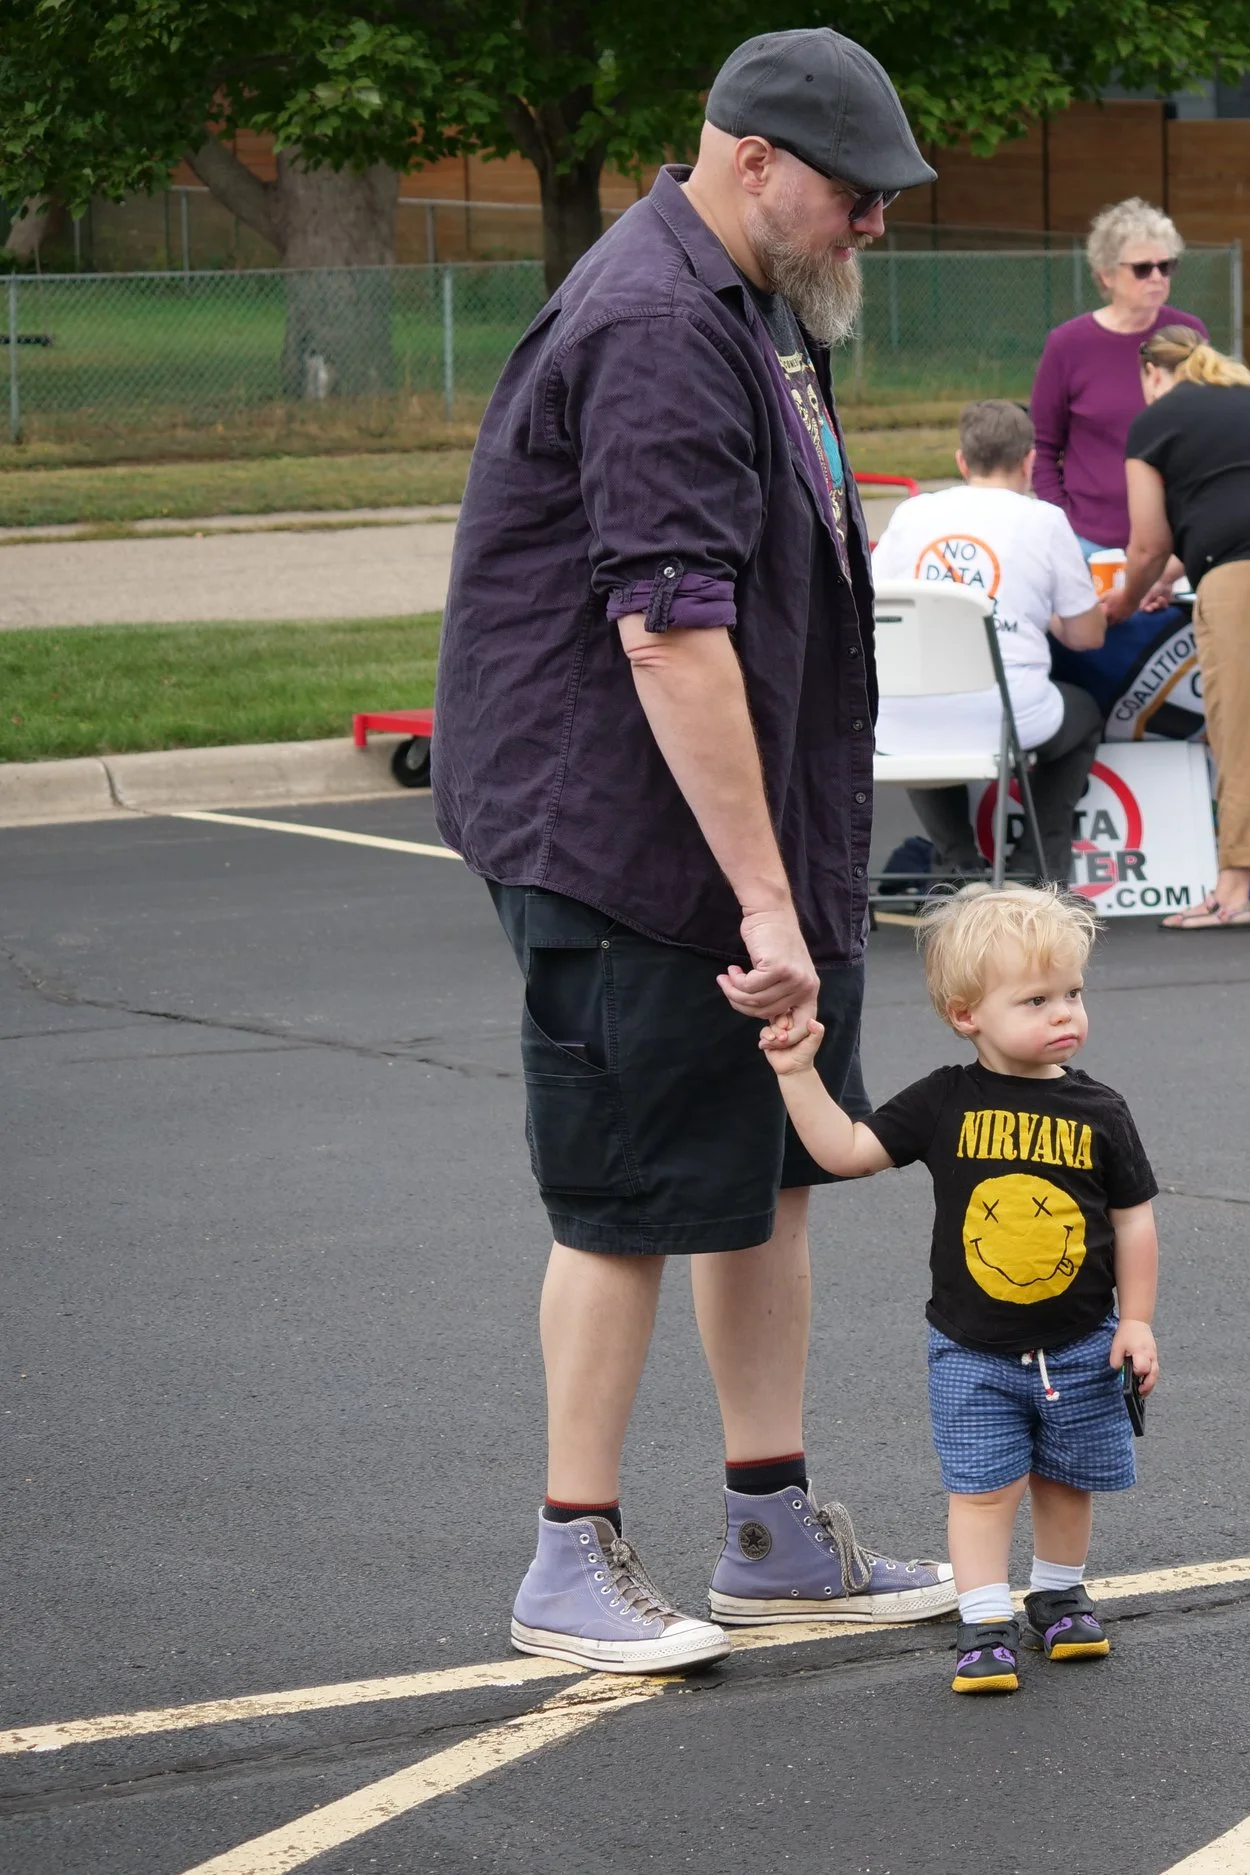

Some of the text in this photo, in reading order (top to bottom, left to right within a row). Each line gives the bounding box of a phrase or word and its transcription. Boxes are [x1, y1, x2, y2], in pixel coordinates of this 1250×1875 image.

[943, 541, 977, 561] NO
[926, 564, 985, 588] DATA
[1106, 885, 1190, 909] .COM
[956, 1110, 1093, 1170] NIRVANA
